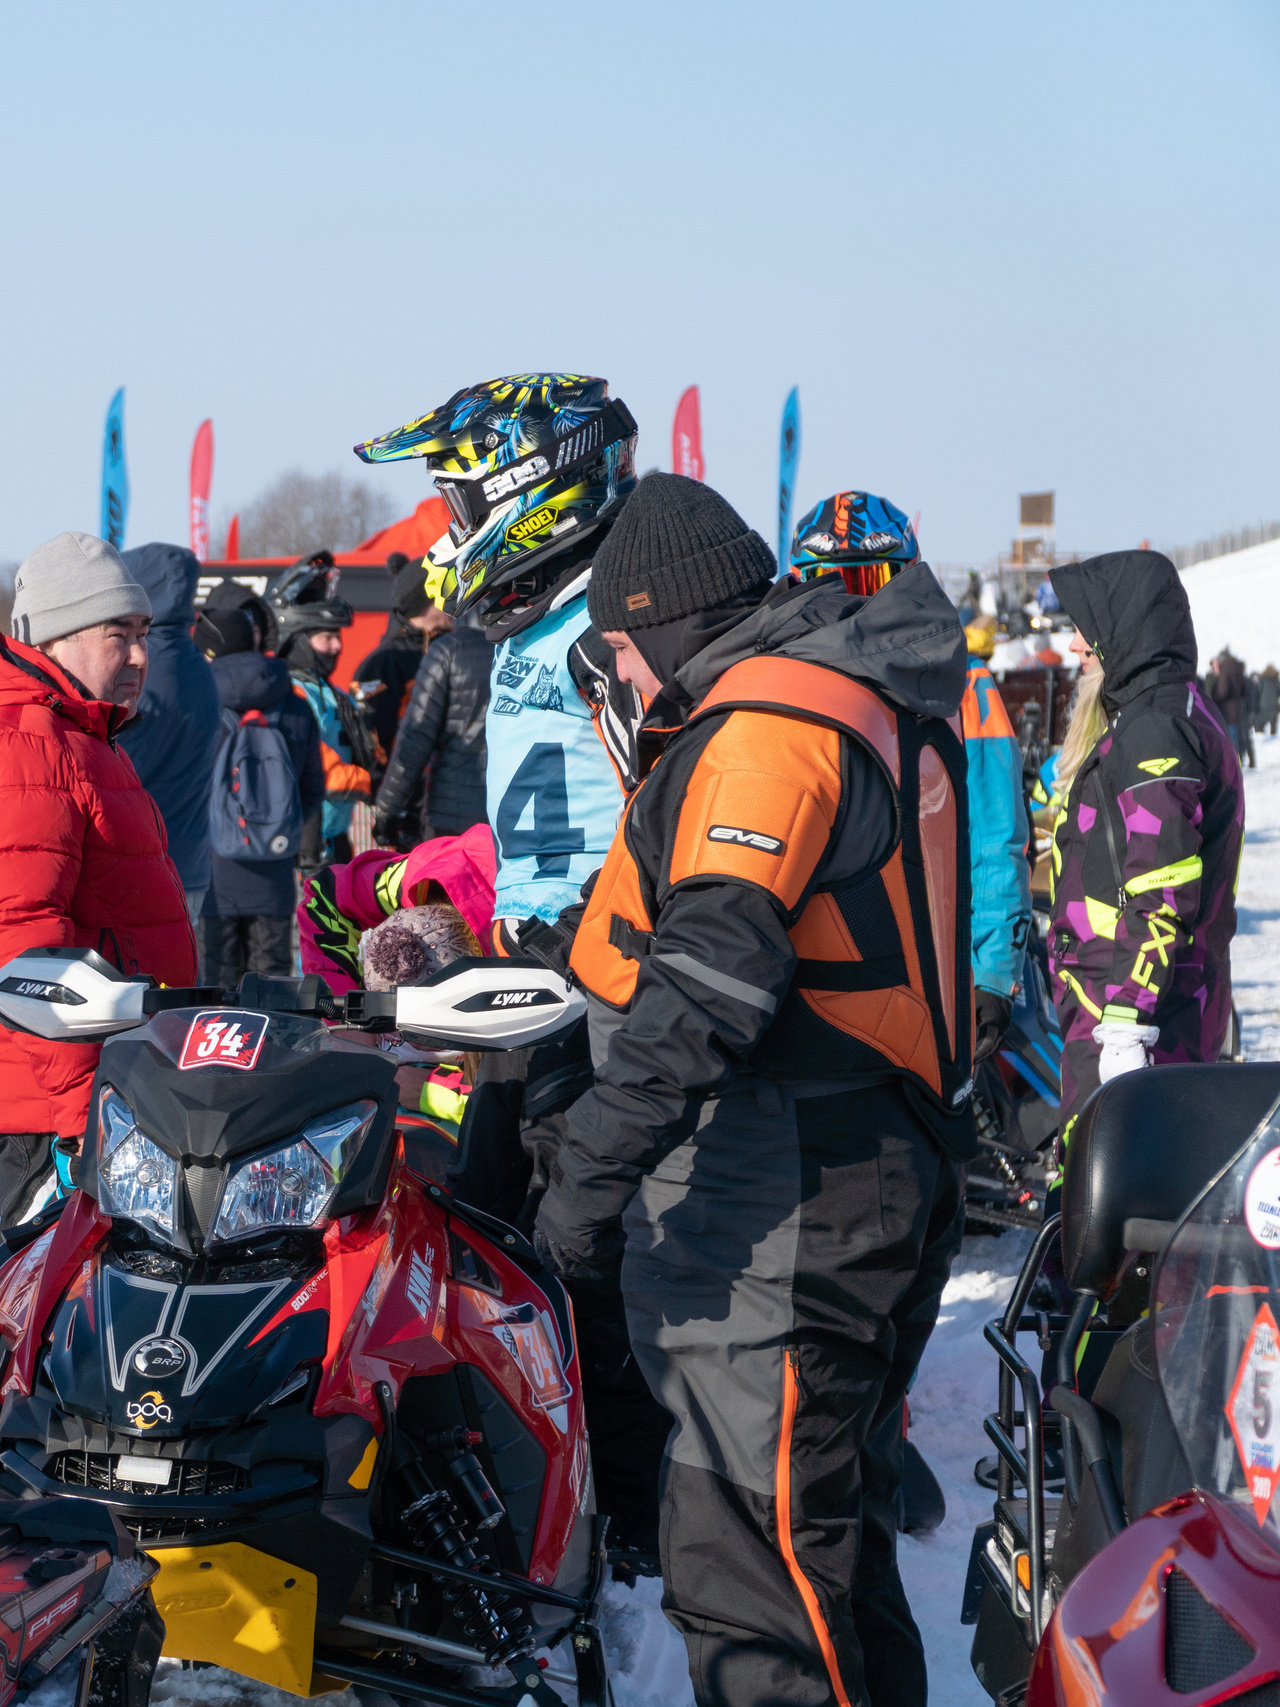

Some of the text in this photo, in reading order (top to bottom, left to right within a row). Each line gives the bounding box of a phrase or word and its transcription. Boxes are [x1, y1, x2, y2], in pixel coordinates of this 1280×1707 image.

[482, 455, 551, 502] 509
[510, 508, 554, 540] SHOEI
[497, 743, 585, 880] 4
[710, 827, 780, 850] EVS
[16, 982, 56, 996] LYNX
[491, 991, 539, 1006] LYNX
[197, 1022, 244, 1057] 34
[311, 1269, 329, 1286] E-TEC
[406, 1249, 433, 1319] LYNX
[152, 1357, 181, 1366] BRP
[521, 1325, 558, 1389] 34
[1253, 1369, 1272, 1439] 5
[28, 1592, 79, 1637] PPS
